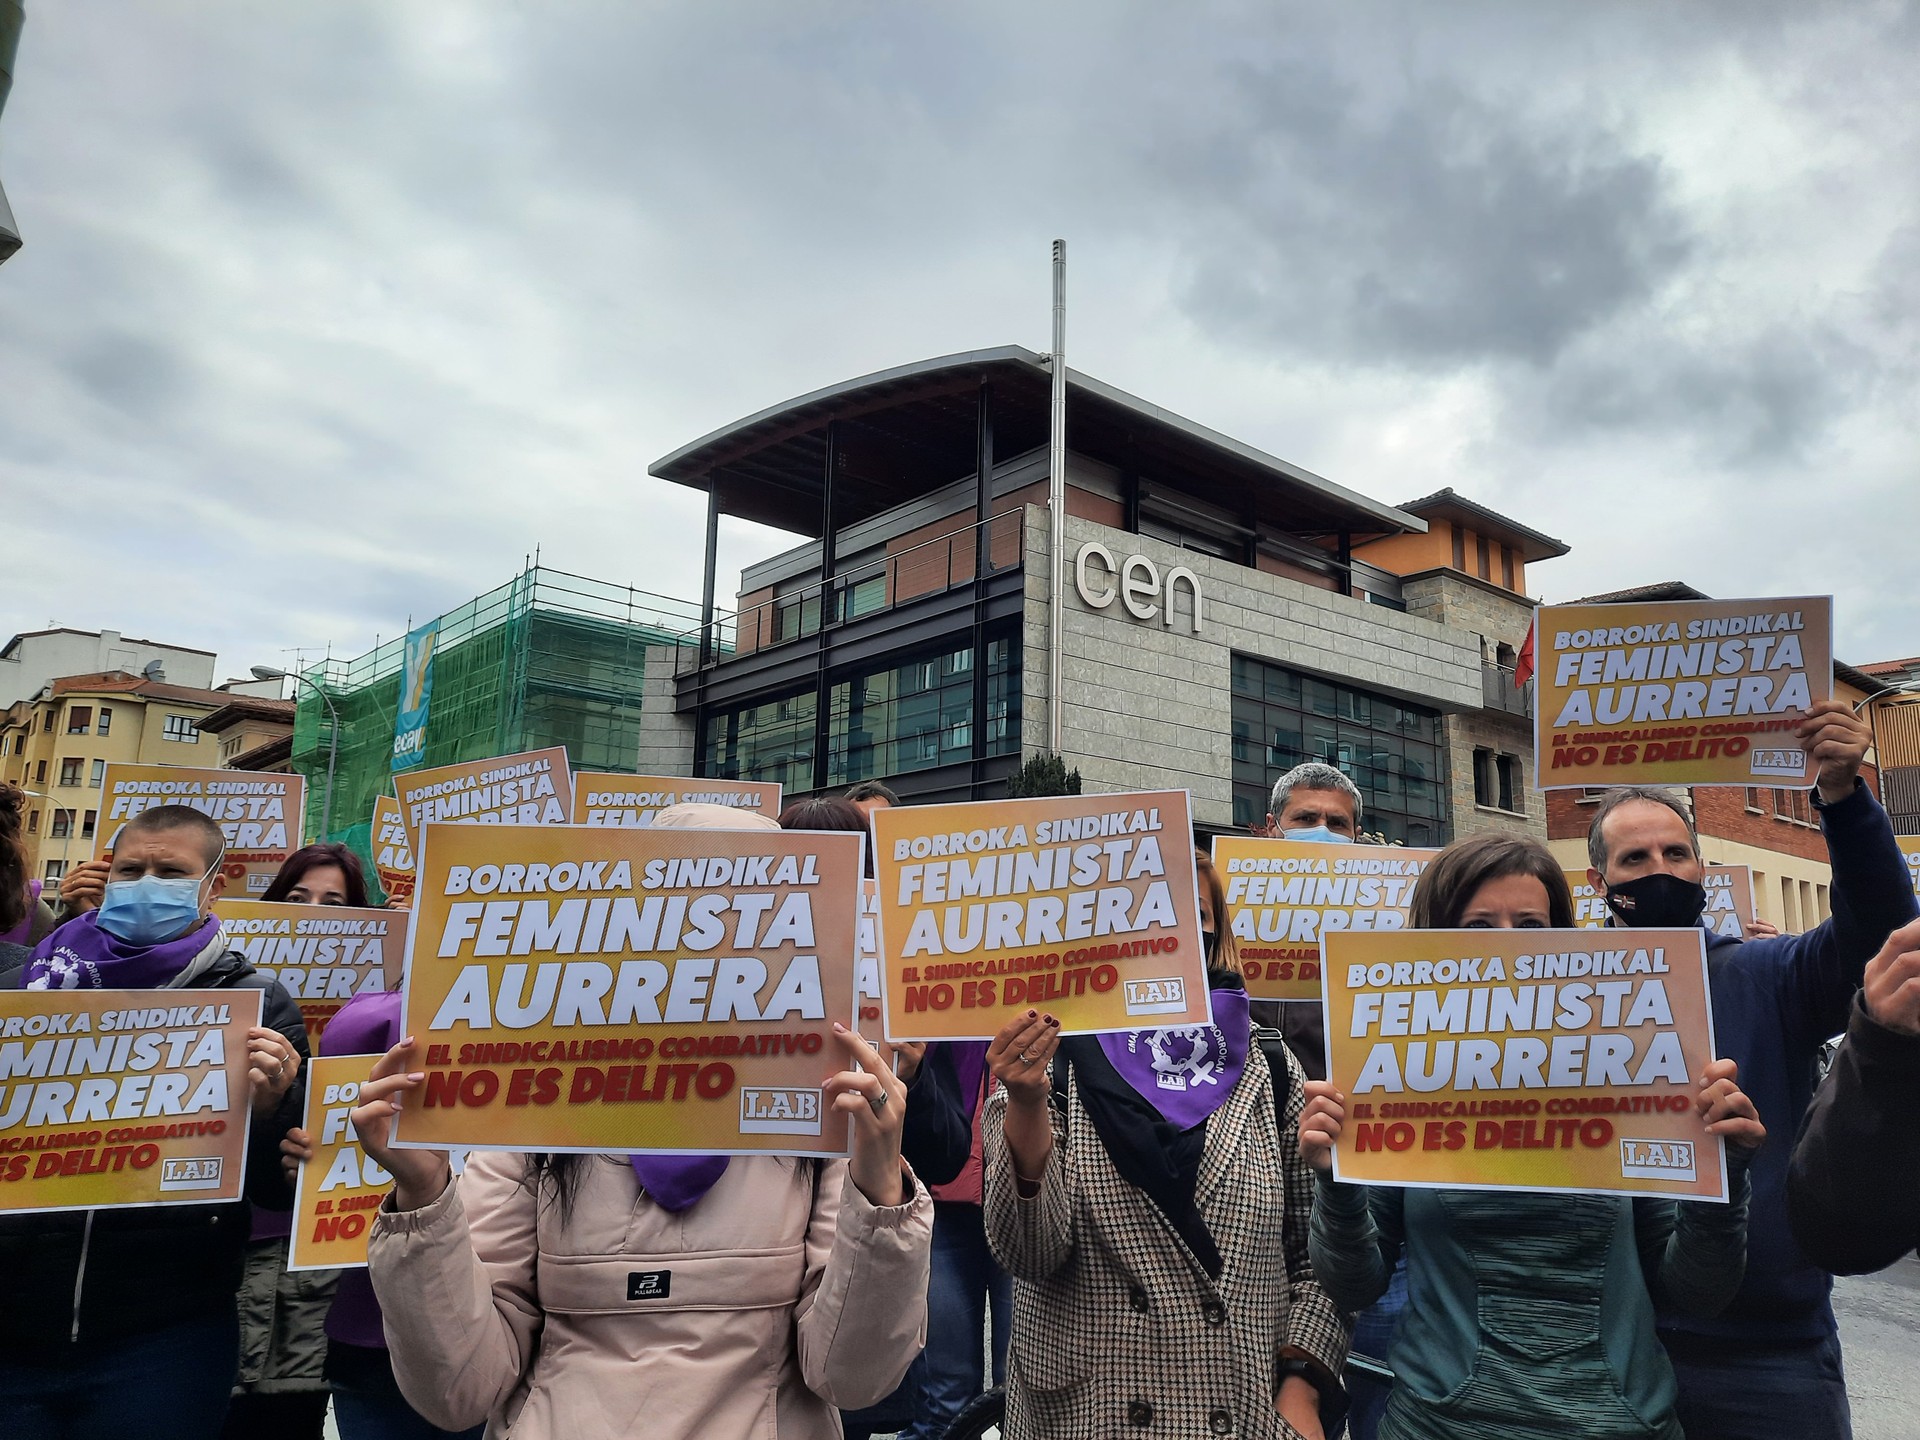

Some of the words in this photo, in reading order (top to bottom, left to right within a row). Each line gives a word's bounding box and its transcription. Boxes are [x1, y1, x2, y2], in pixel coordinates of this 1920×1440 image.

[1075, 541, 1202, 632] cen
[1553, 622, 1681, 650] BORROKA
[1685, 611, 1805, 640] SINDIKAL
[1554, 634, 1804, 687] FEMINISTA
[1553, 672, 1812, 728] AURRERA
[1552, 734, 1570, 747] EL
[1572, 725, 1697, 744] SINDICALISMO
[1700, 718, 1802, 736] COMBATIV
[1551, 745, 1599, 769] NO
[1602, 743, 1637, 766] ES
[1641, 736, 1750, 763] DELITO
[1754, 751, 1804, 768] LAB
[112, 781, 201, 795] BORROKA
[205, 781, 287, 796] SINDIKAL
[406, 776, 477, 804] BORROKA
[480, 758, 552, 786] SINDIKAL
[410, 774, 556, 828] FEMINISTA
[585, 791, 676, 807] BORROKA
[680, 791, 762, 808] SINDIKAL
[893, 824, 1029, 862] BORROKA
[1034, 808, 1163, 845] SINDIKAL
[443, 860, 632, 896] BORROKA
[640, 855, 821, 891] SINDIKAL
[897, 836, 1165, 907] FEMINISTA
[1227, 858, 1329, 874] BORROKA
[295, 919, 388, 935] SINDIKAL
[437, 892, 816, 958] FEMINISTA
[900, 880, 1179, 959] AURRERA
[902, 967, 920, 983] EL
[924, 952, 1060, 981] SINDICALISMO
[1062, 936, 1179, 973] COMBATIVO
[1266, 962, 1295, 981] ES
[1346, 957, 1506, 989] BORROKA
[1512, 947, 1670, 980] SINDIKAL
[427, 955, 826, 1031] AURRERA
[904, 983, 955, 1013] NO
[961, 980, 997, 1009] ES
[1002, 964, 1118, 1007] DELITO
[1125, 979, 1184, 1006] LAB
[98, 1004, 231, 1032] SINDIKAL
[1350, 979, 1675, 1038] FEMINISTA
[425, 1044, 454, 1066] EL
[457, 1037, 654, 1065] SINDICALISMO
[658, 1032, 823, 1060] COMBATIVO
[1352, 1031, 1690, 1094] AURRERA
[422, 1069, 499, 1109] NO
[505, 1067, 563, 1107] ES
[568, 1062, 736, 1105] DELITO
[1158, 1074, 1185, 1087] LAB
[743, 1090, 818, 1121] LAB
[1353, 1102, 1375, 1119] EL
[1379, 1098, 1542, 1119] SINDICALISMO
[1545, 1095, 1690, 1116] COMBATIVO
[105, 1119, 227, 1143] COMBATIVO
[1354, 1122, 1416, 1153] NO
[1421, 1121, 1468, 1151] ES
[1473, 1118, 1614, 1151] DELITO
[33, 1143, 160, 1179] DELITO
[163, 1159, 220, 1181] LAB
[1624, 1141, 1694, 1169] LAB
[315, 1200, 334, 1215] EL
[312, 1213, 366, 1243] NO
